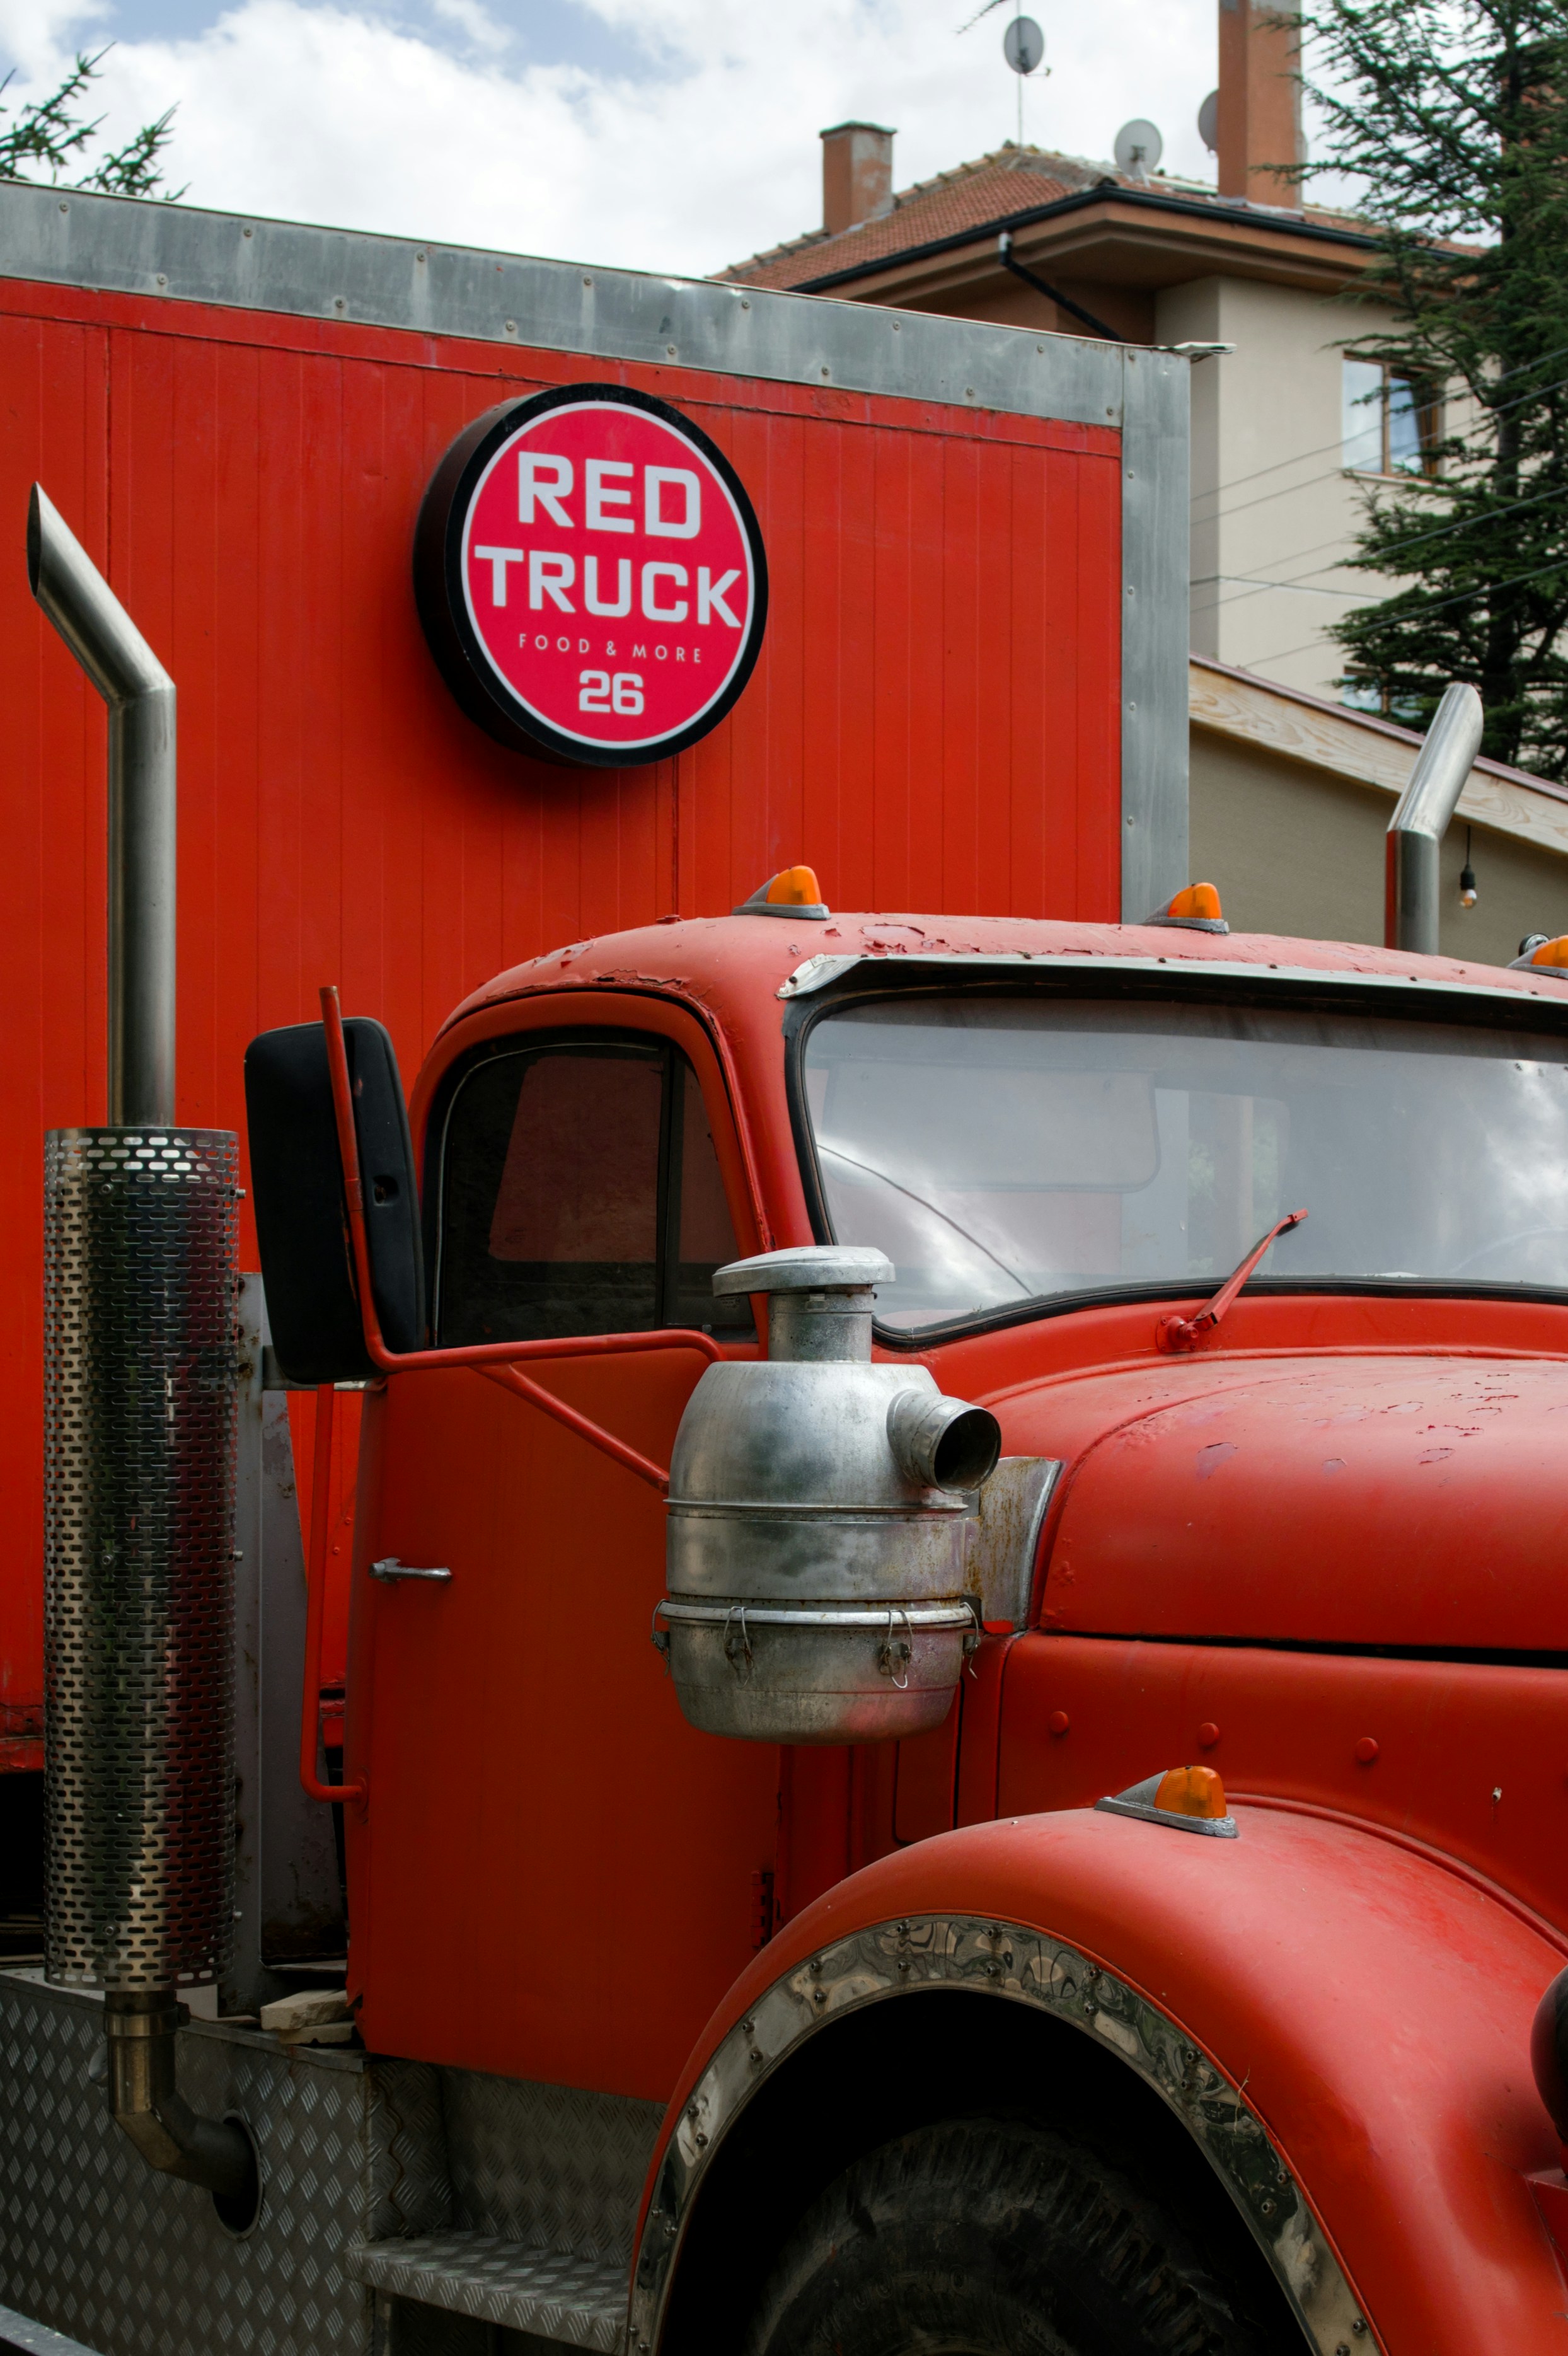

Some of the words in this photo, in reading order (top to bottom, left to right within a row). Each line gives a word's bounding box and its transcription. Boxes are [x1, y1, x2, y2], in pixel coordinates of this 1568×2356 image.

[518, 451, 701, 540] RED
[474, 545, 742, 628] TRUCK
[519, 633, 590, 654] FOOD
[606, 640, 616, 656] &
[632, 644, 701, 663] MORE
[579, 669, 645, 715] 26
